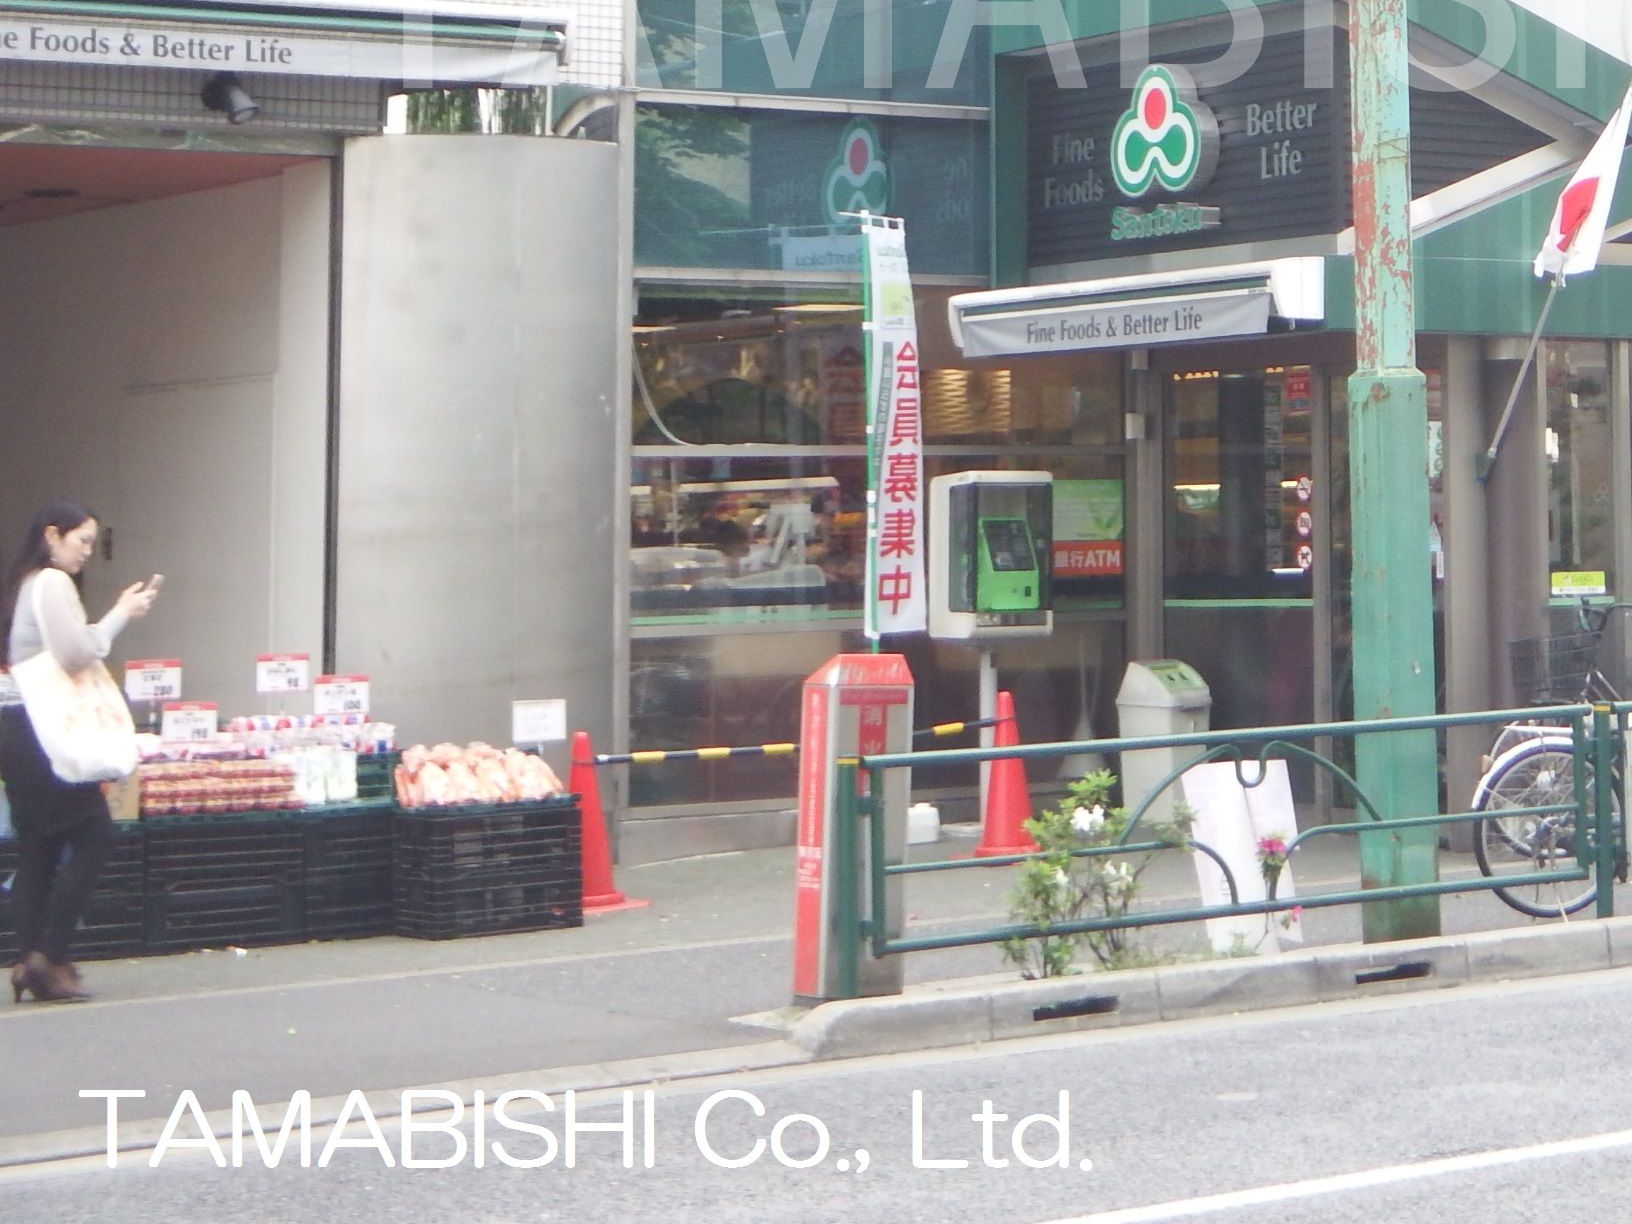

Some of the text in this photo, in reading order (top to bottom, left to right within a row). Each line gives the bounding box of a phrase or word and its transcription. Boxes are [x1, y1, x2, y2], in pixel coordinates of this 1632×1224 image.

[30, 26, 110, 55] Foods
[119, 32, 141, 56] &
[153, 34, 235, 61] Better
[245, 39, 293, 64] Life
[1246, 99, 1318, 137] Better
[1053, 134, 1095, 165] Fine
[1260, 139, 1303, 179] Life
[1044, 169, 1104, 208] Foods
[1111, 203, 1206, 241] Santoku
[1026, 306, 1203, 344] Fine Foods & Better Life
